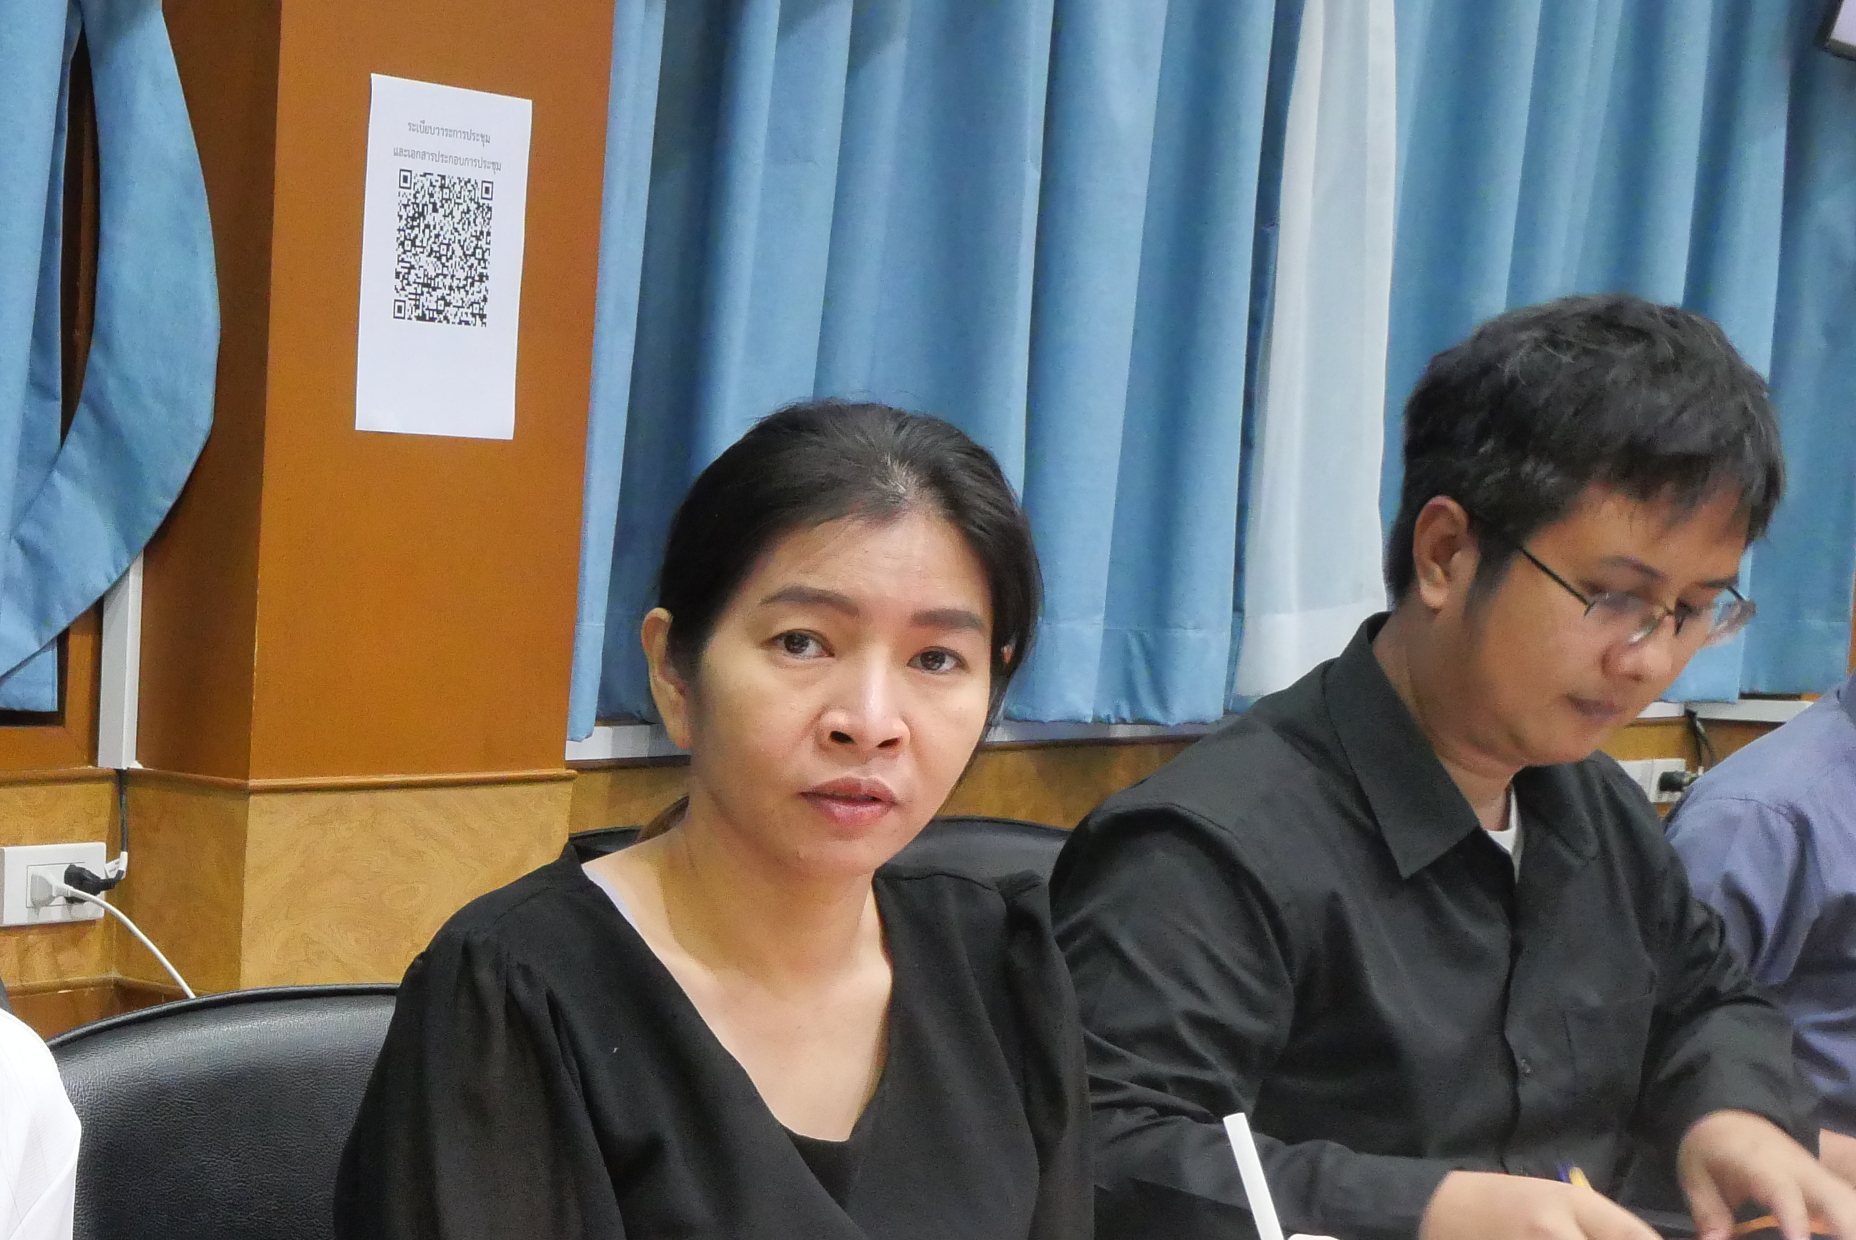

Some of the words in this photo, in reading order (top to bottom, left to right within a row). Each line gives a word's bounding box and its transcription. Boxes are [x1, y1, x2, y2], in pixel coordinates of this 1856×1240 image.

[393, 146, 502, 175] และเอกสารประกอบการประชุม
